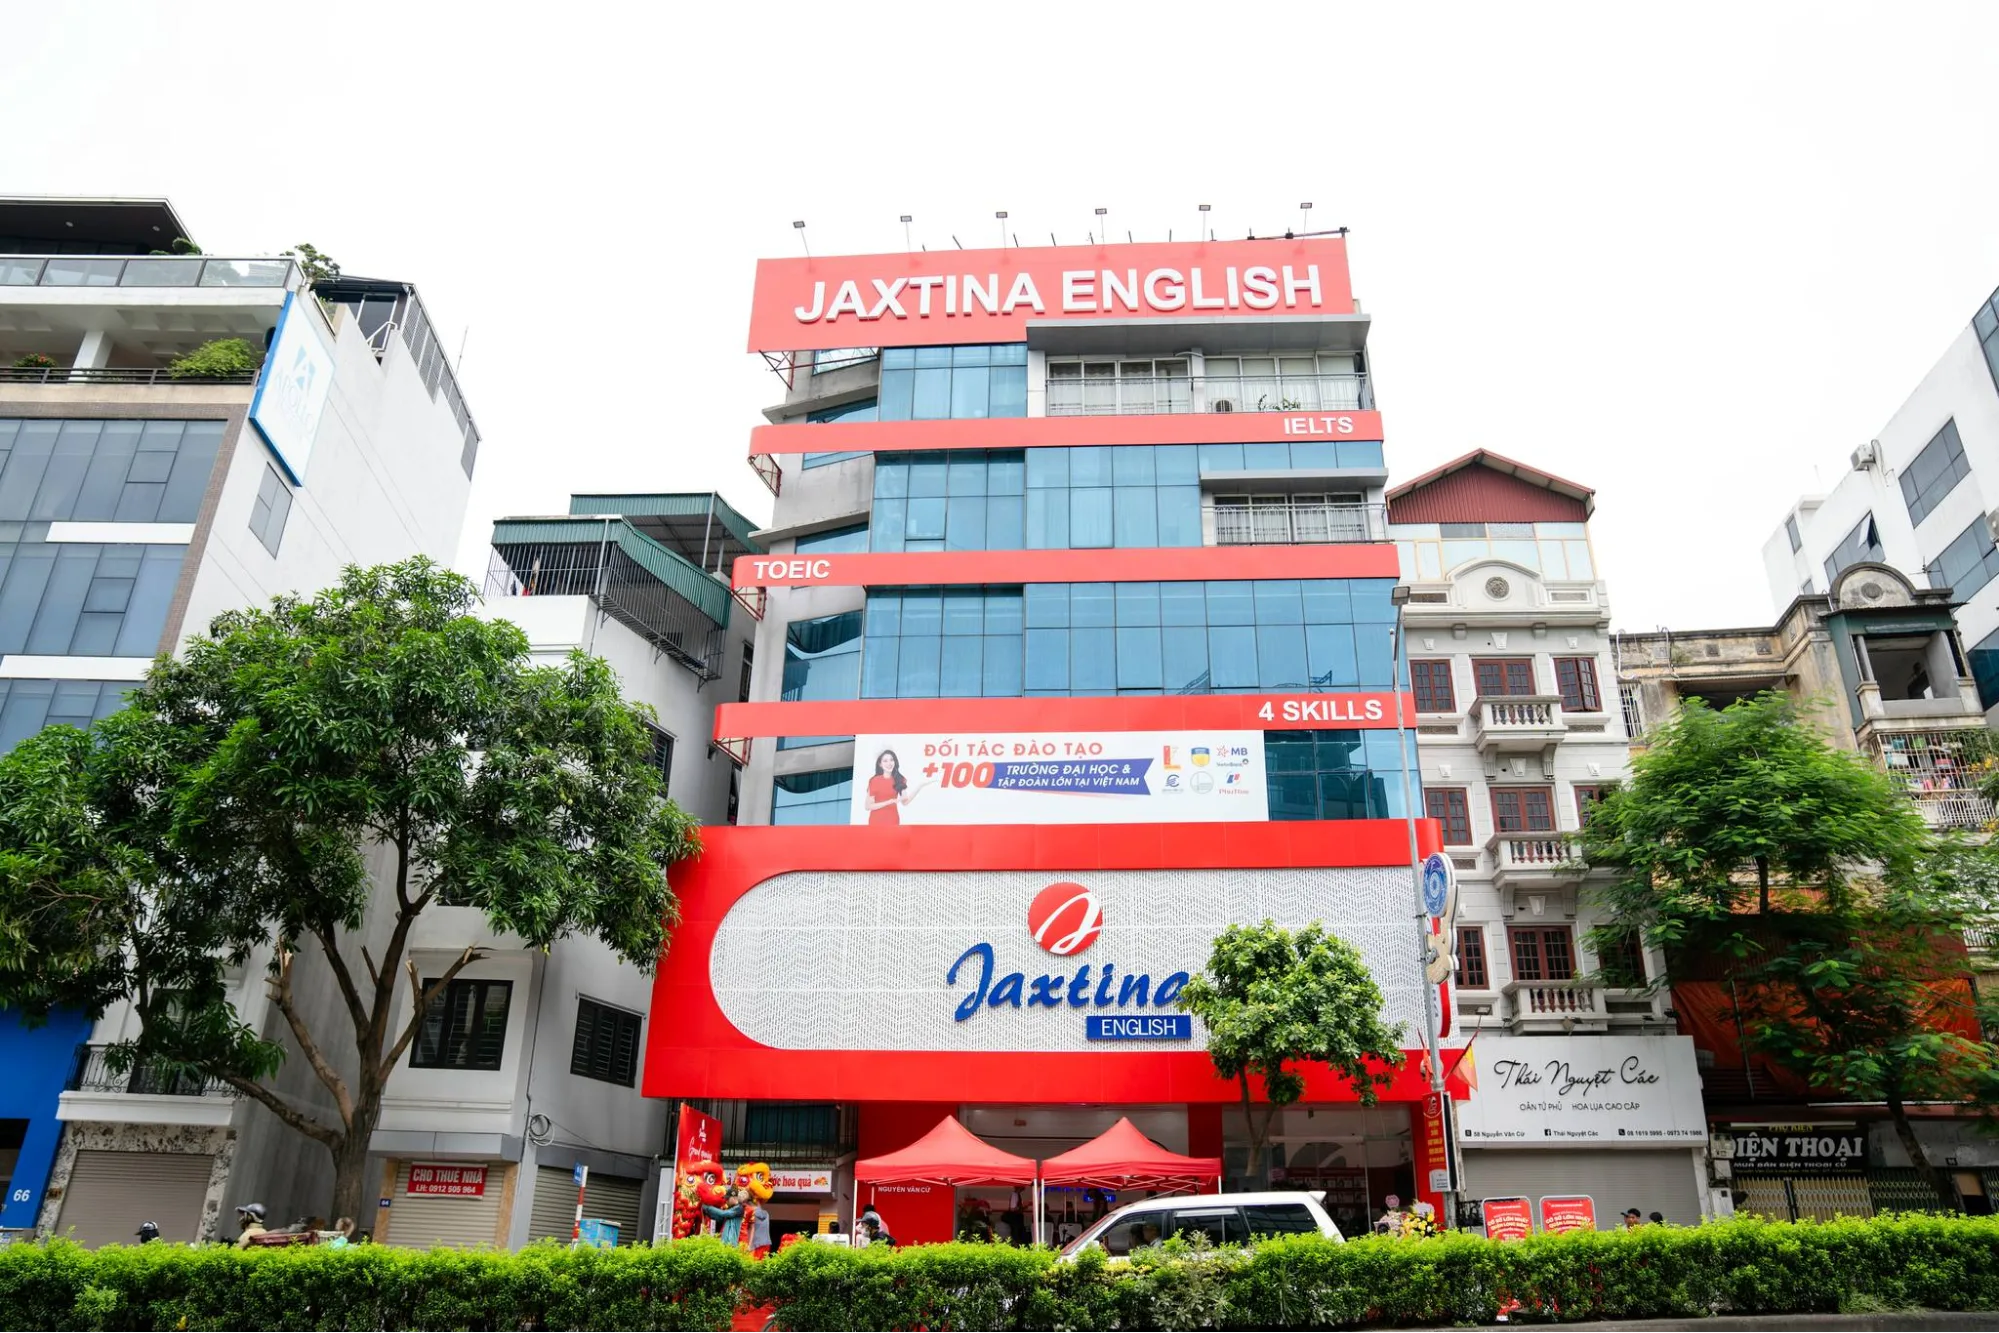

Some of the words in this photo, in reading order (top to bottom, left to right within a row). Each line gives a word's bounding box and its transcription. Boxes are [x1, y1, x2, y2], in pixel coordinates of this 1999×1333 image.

[794, 272, 1045, 323] JAXTINA
[1063, 265, 1322, 314] ENGLISH
[1284, 416, 1353, 435] IELTS
[753, 559, 831, 580] TOEIC
[1258, 701, 1275, 722] 4
[1283, 699, 1383, 721] SKILLS
[924, 739, 959, 757] ĐỐI
[968, 740, 1005, 756] TÁC
[1013, 740, 1056, 756] ĐÀO
[1064, 742, 1103, 759] TẠO
[1231, 747, 1248, 756] MB
[923, 761, 996, 788] +100
[1007, 763, 1060, 775] TRƯỜNG
[1062, 764, 1085, 777] ĐẠI
[1089, 764, 1118, 777] HỌC
[1121, 764, 1131, 774] &
[998, 777, 1016, 788] TẬP
[1018, 776, 1049, 787] ĐOÀN
[1051, 776, 1073, 787] LỚN
[1074, 777, 1090, 788] TẠI
[1093, 776, 1115, 788] VIỆT
[1115, 777, 1140, 786] NAM
[946, 942, 1190, 1022] Jaxtina
[1101, 1019, 1177, 1036] ENGLISH
[1493, 1059, 1542, 1089] Thái
[1545, 1060, 1615, 1096] Nguyệt
[1620, 1056, 1660, 1084] Các
[1572, 1102, 1588, 1111] HOA
[1604, 1102, 1623, 1111] CAO
[1785, 1137, 1863, 1162] THOẠI
[412, 1168, 433, 1182] CHO
[461, 1168, 484, 1184] NHÀ
[783, 1175, 796, 1187] hoa
[797, 1174, 812, 1189] quả
[13, 1188, 31, 1202] 66
[428, 1184, 446, 1193] 0912
[878, 1185, 905, 1193] NGUYỄN
